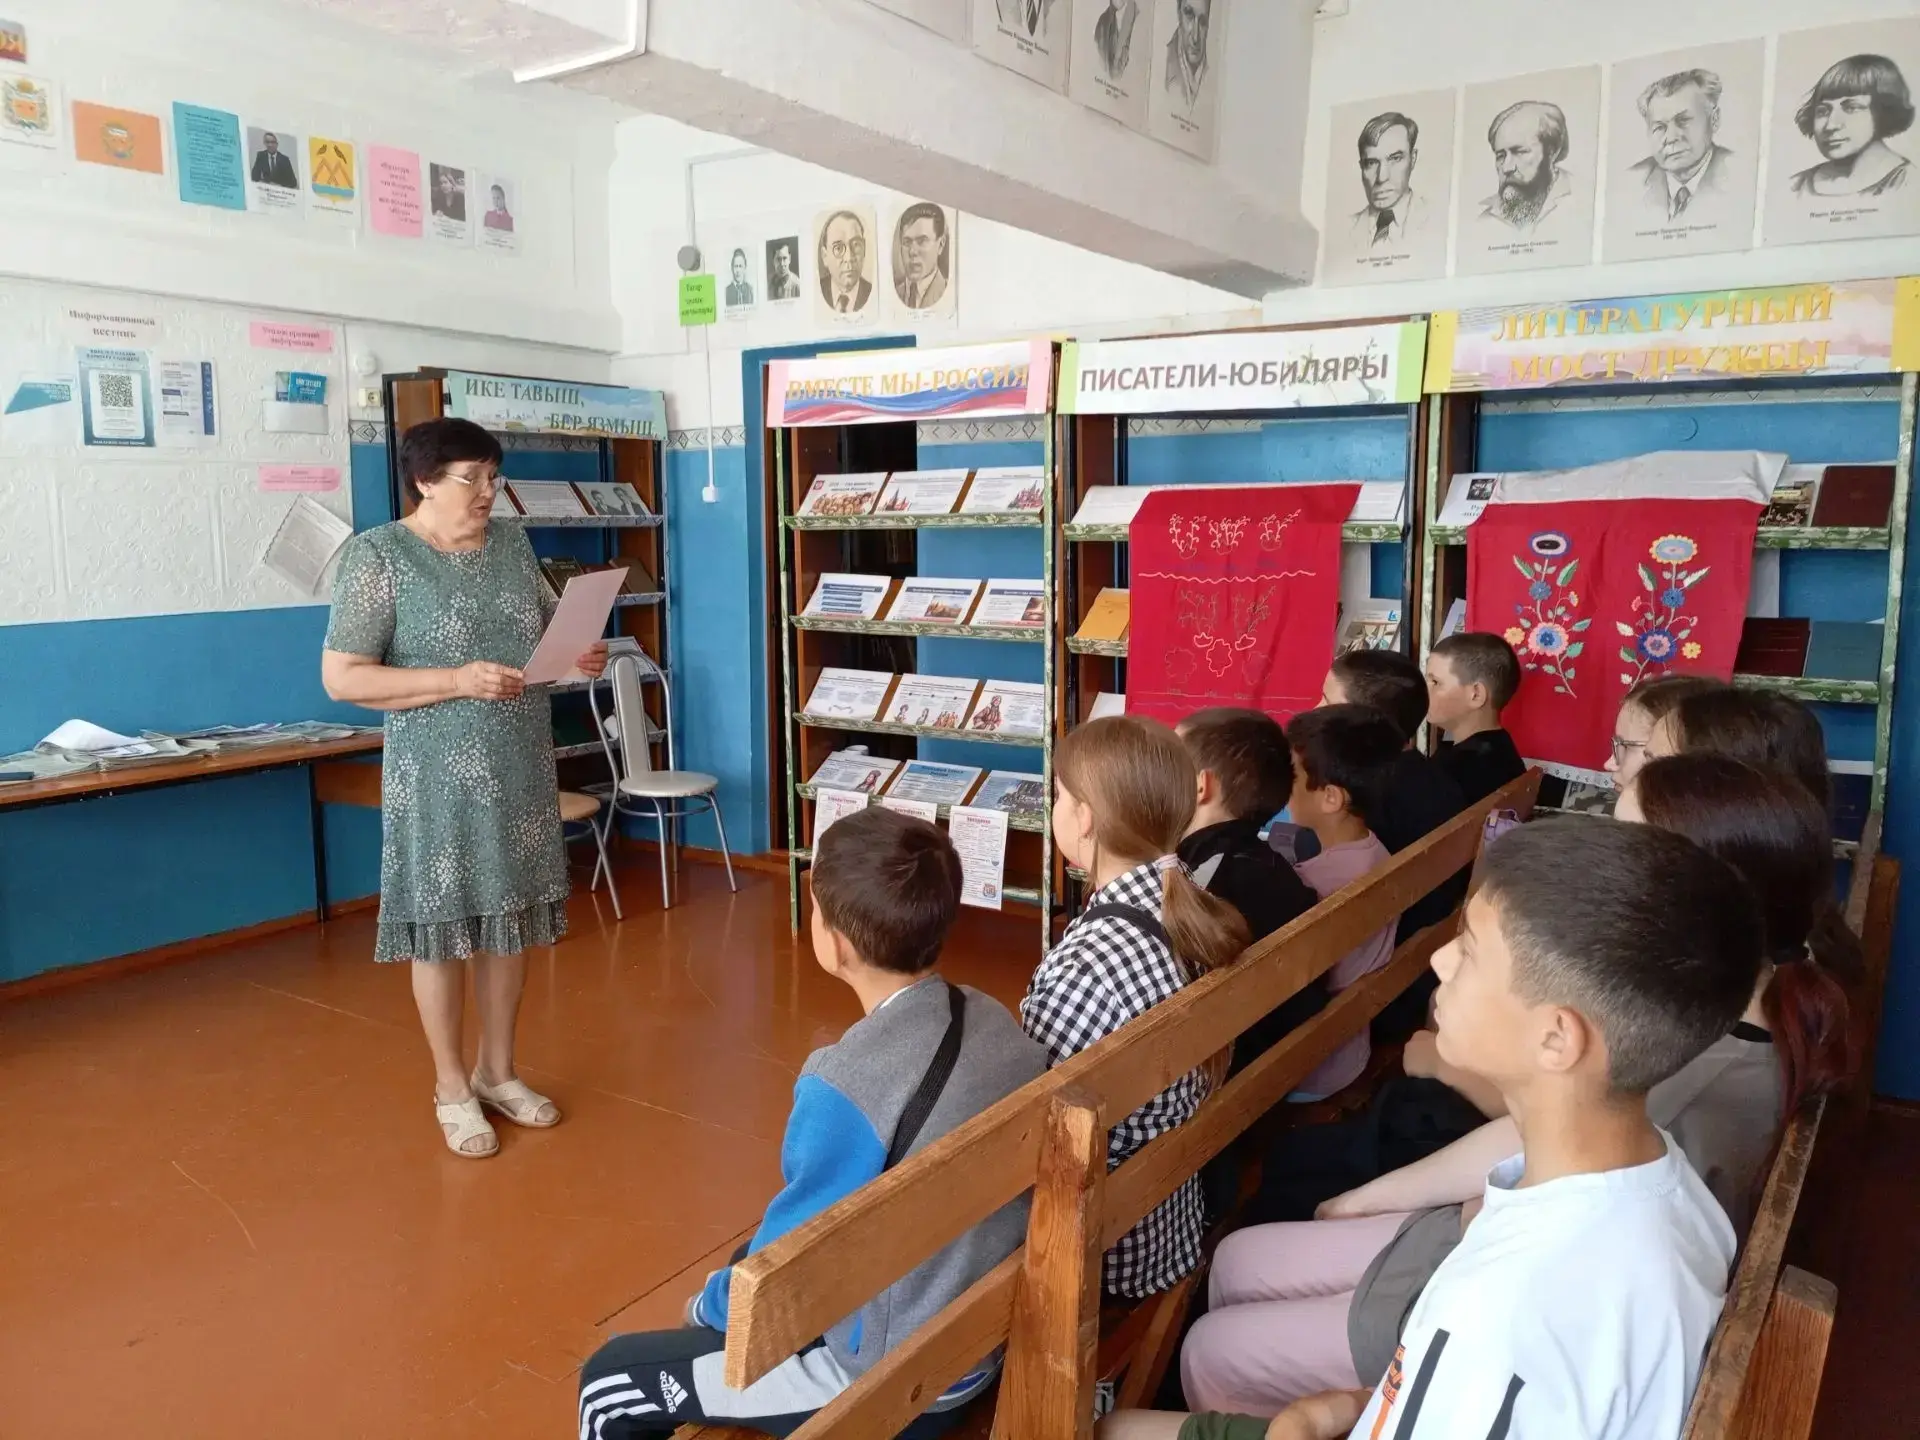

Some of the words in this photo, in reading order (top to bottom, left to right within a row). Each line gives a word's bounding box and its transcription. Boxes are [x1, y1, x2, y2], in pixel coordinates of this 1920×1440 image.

[1492, 284, 1833, 341] ЛИТЕРАТУРНЫЙ
[1080, 354, 1389, 391] ПИСАТЕЛИ-ЮБИЛЯРЫ
[1508, 352, 1627, 384] МОСТ
[1632, 340, 1830, 380] ДРУЖБЫ
[465, 378, 506, 398] ИКЕ
[788, 375, 874, 399] ВМЕСТЕ
[880, 364, 1028, 395] МЫ-РОССИЯ
[550, 413, 584, 430] БЕР
[660, 1371, 676, 1413] adidas
